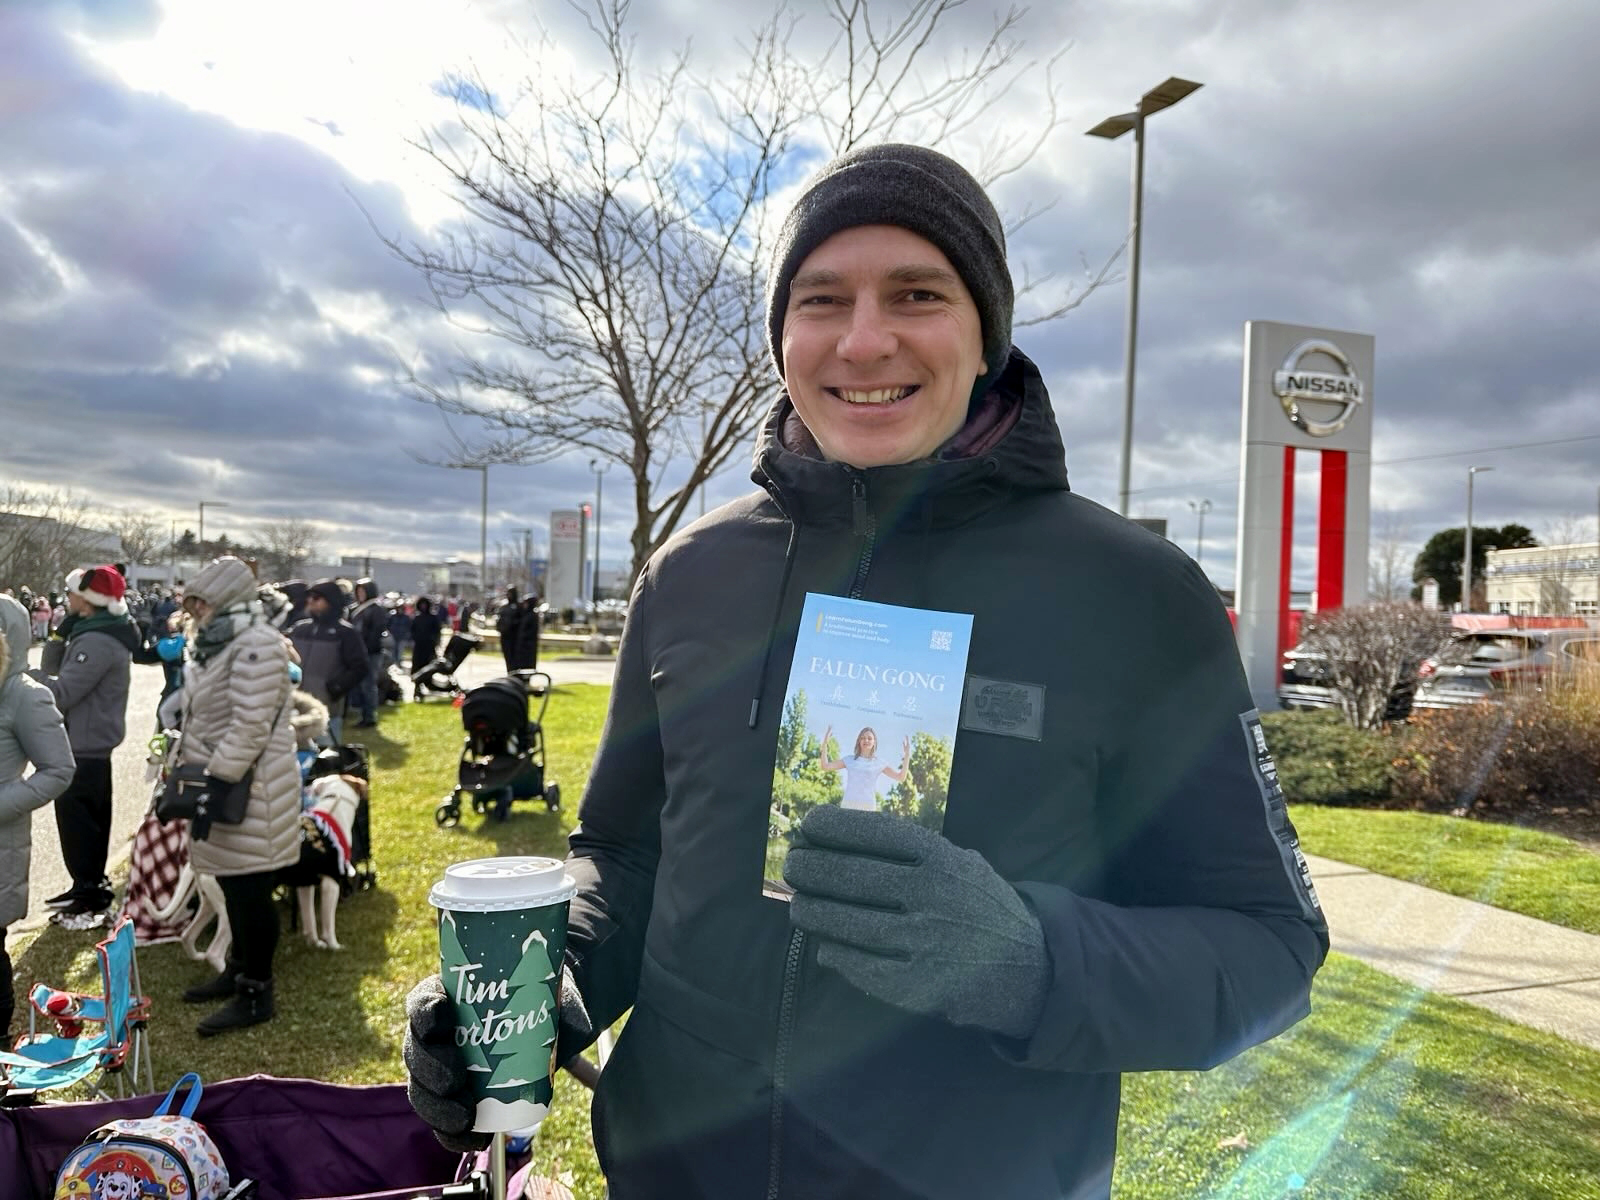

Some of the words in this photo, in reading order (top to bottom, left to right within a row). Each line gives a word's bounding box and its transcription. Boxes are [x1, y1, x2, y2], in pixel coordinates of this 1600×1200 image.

[1287, 376, 1359, 397] NISSAN
[809, 656, 879, 681] FALUN
[882, 668, 945, 692] GONG
[449, 963, 509, 1006] Tim
[455, 1000, 549, 1047] ortons
